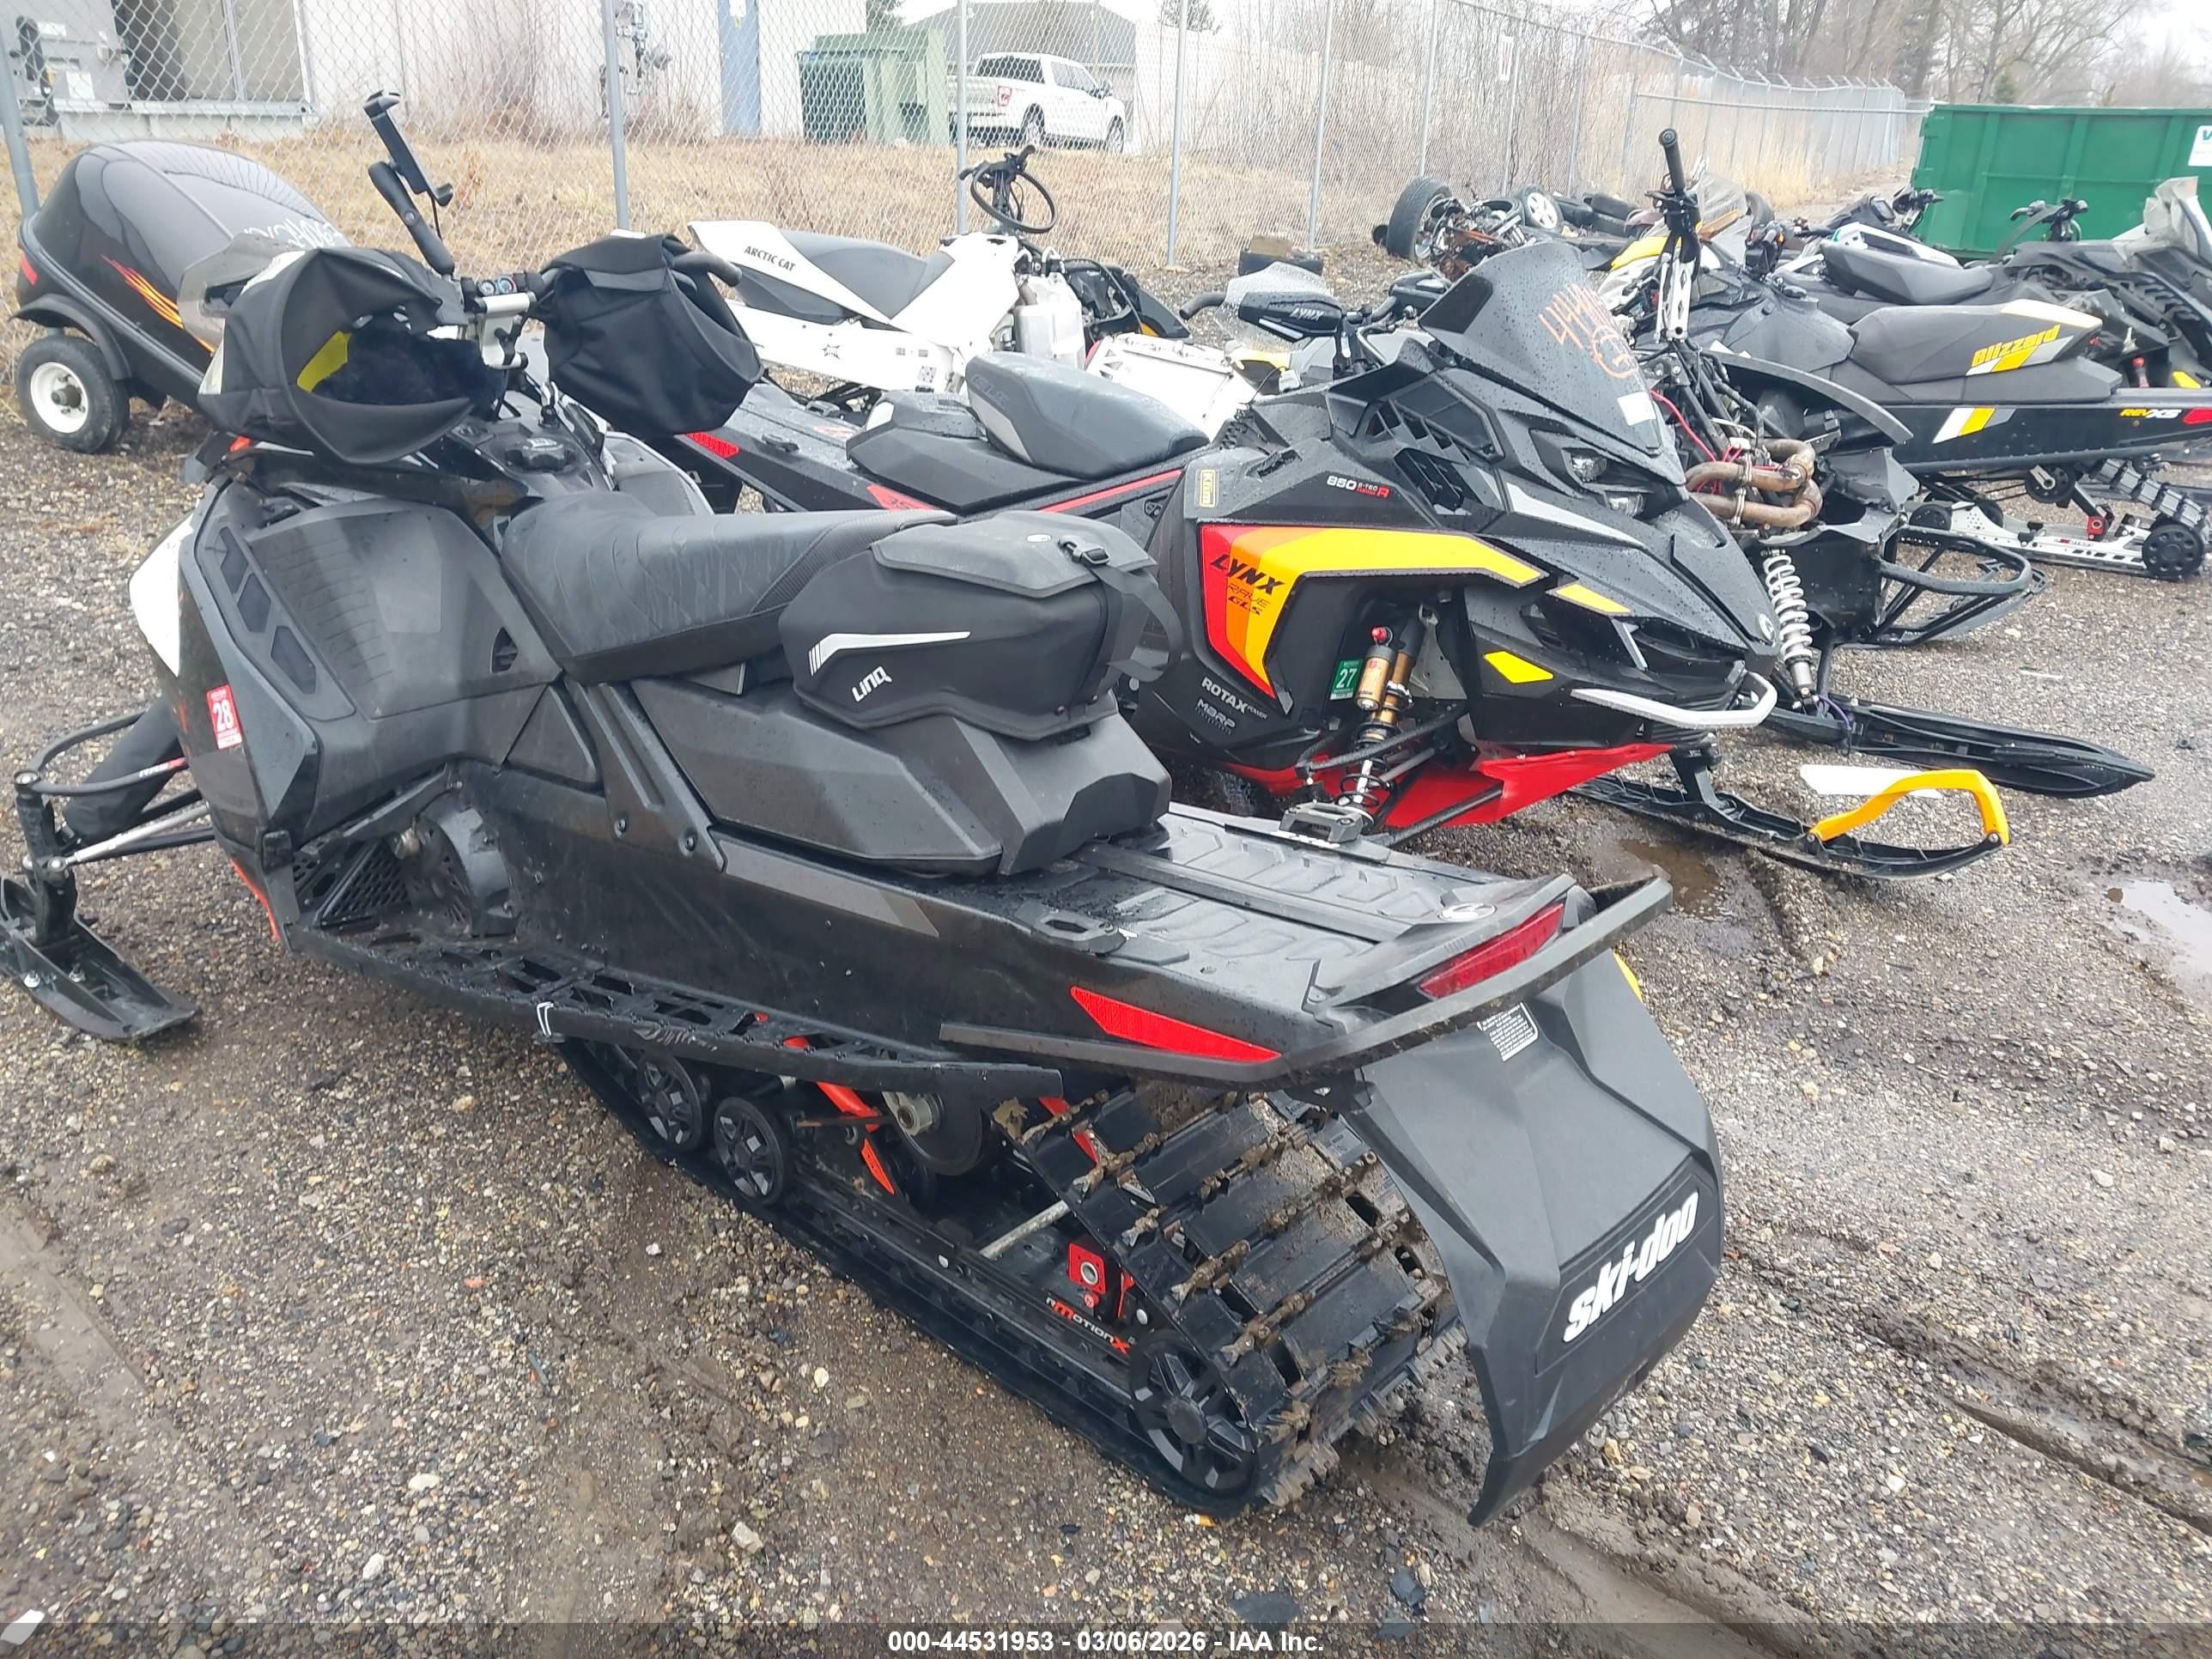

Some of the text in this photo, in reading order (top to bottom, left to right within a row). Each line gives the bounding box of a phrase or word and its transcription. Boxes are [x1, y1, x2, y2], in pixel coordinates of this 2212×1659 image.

[744, 246, 805, 271] ARCTIC CAT
[1290, 307, 1325, 322] LYNX
[1971, 324, 2061, 368] Blizzard
[1327, 475, 1357, 490] 850
[1210, 553, 1285, 595] LYNX
[1227, 583, 1270, 609] RAVE
[1228, 595, 1263, 616] GLS
[1335, 668, 1358, 689] 27
[1201, 676, 1248, 714] ROTAX
[212, 699, 234, 732] 28
[1563, 1191, 1698, 1342] ski-doo
